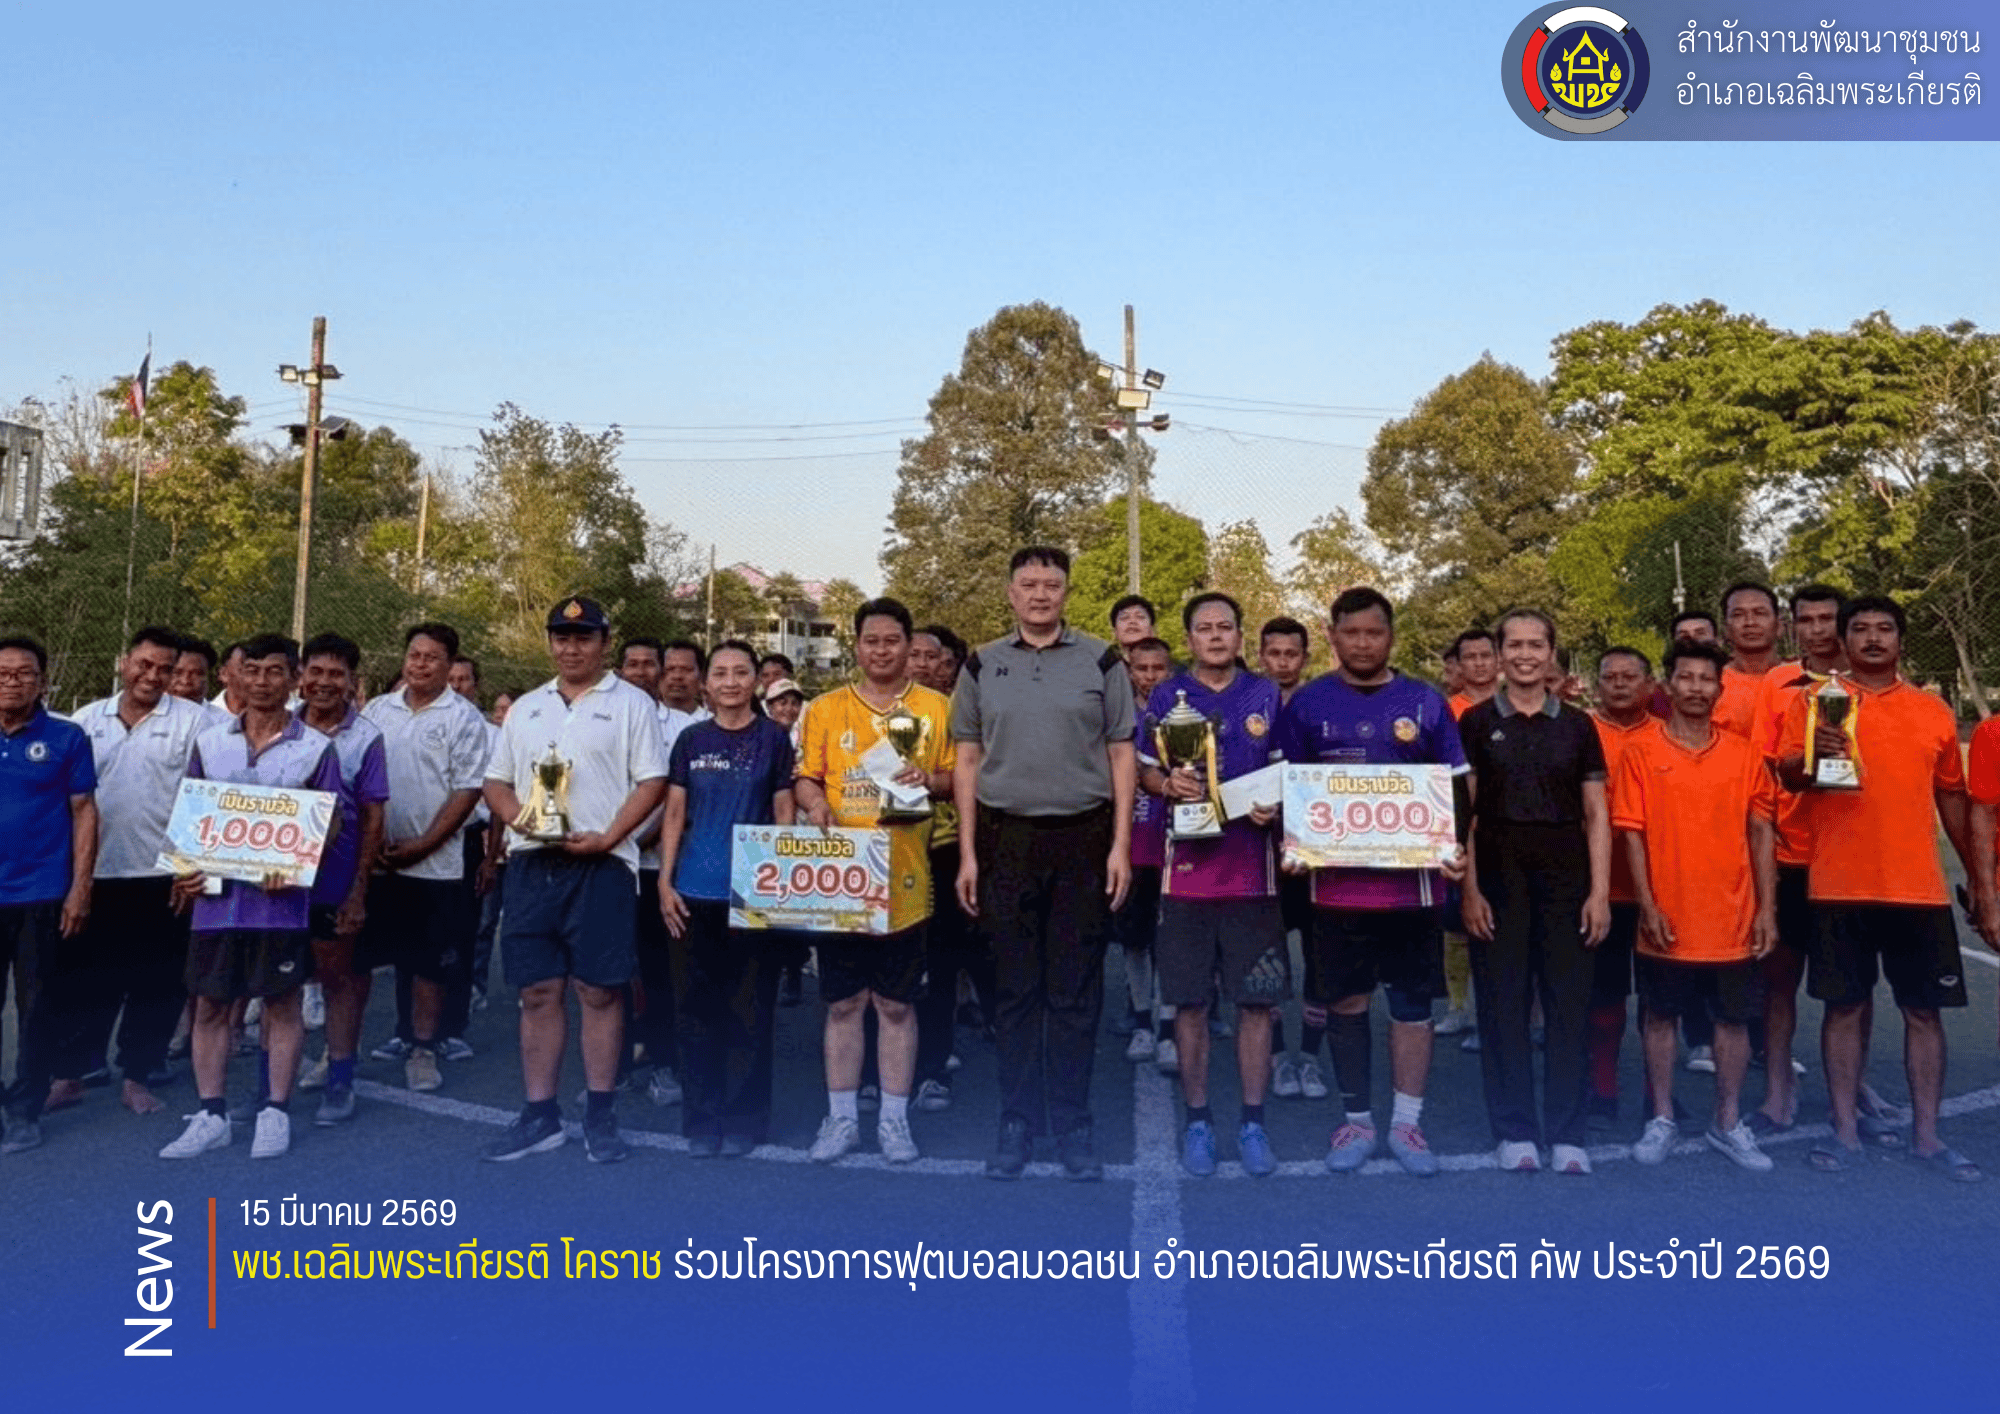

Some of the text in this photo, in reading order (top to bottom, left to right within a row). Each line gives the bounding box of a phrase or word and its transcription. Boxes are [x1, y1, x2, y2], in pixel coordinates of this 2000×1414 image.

[198, 814, 302, 852] 1,000
[1308, 800, 1433, 839] 3,000
[754, 861, 869, 901] 2,000
